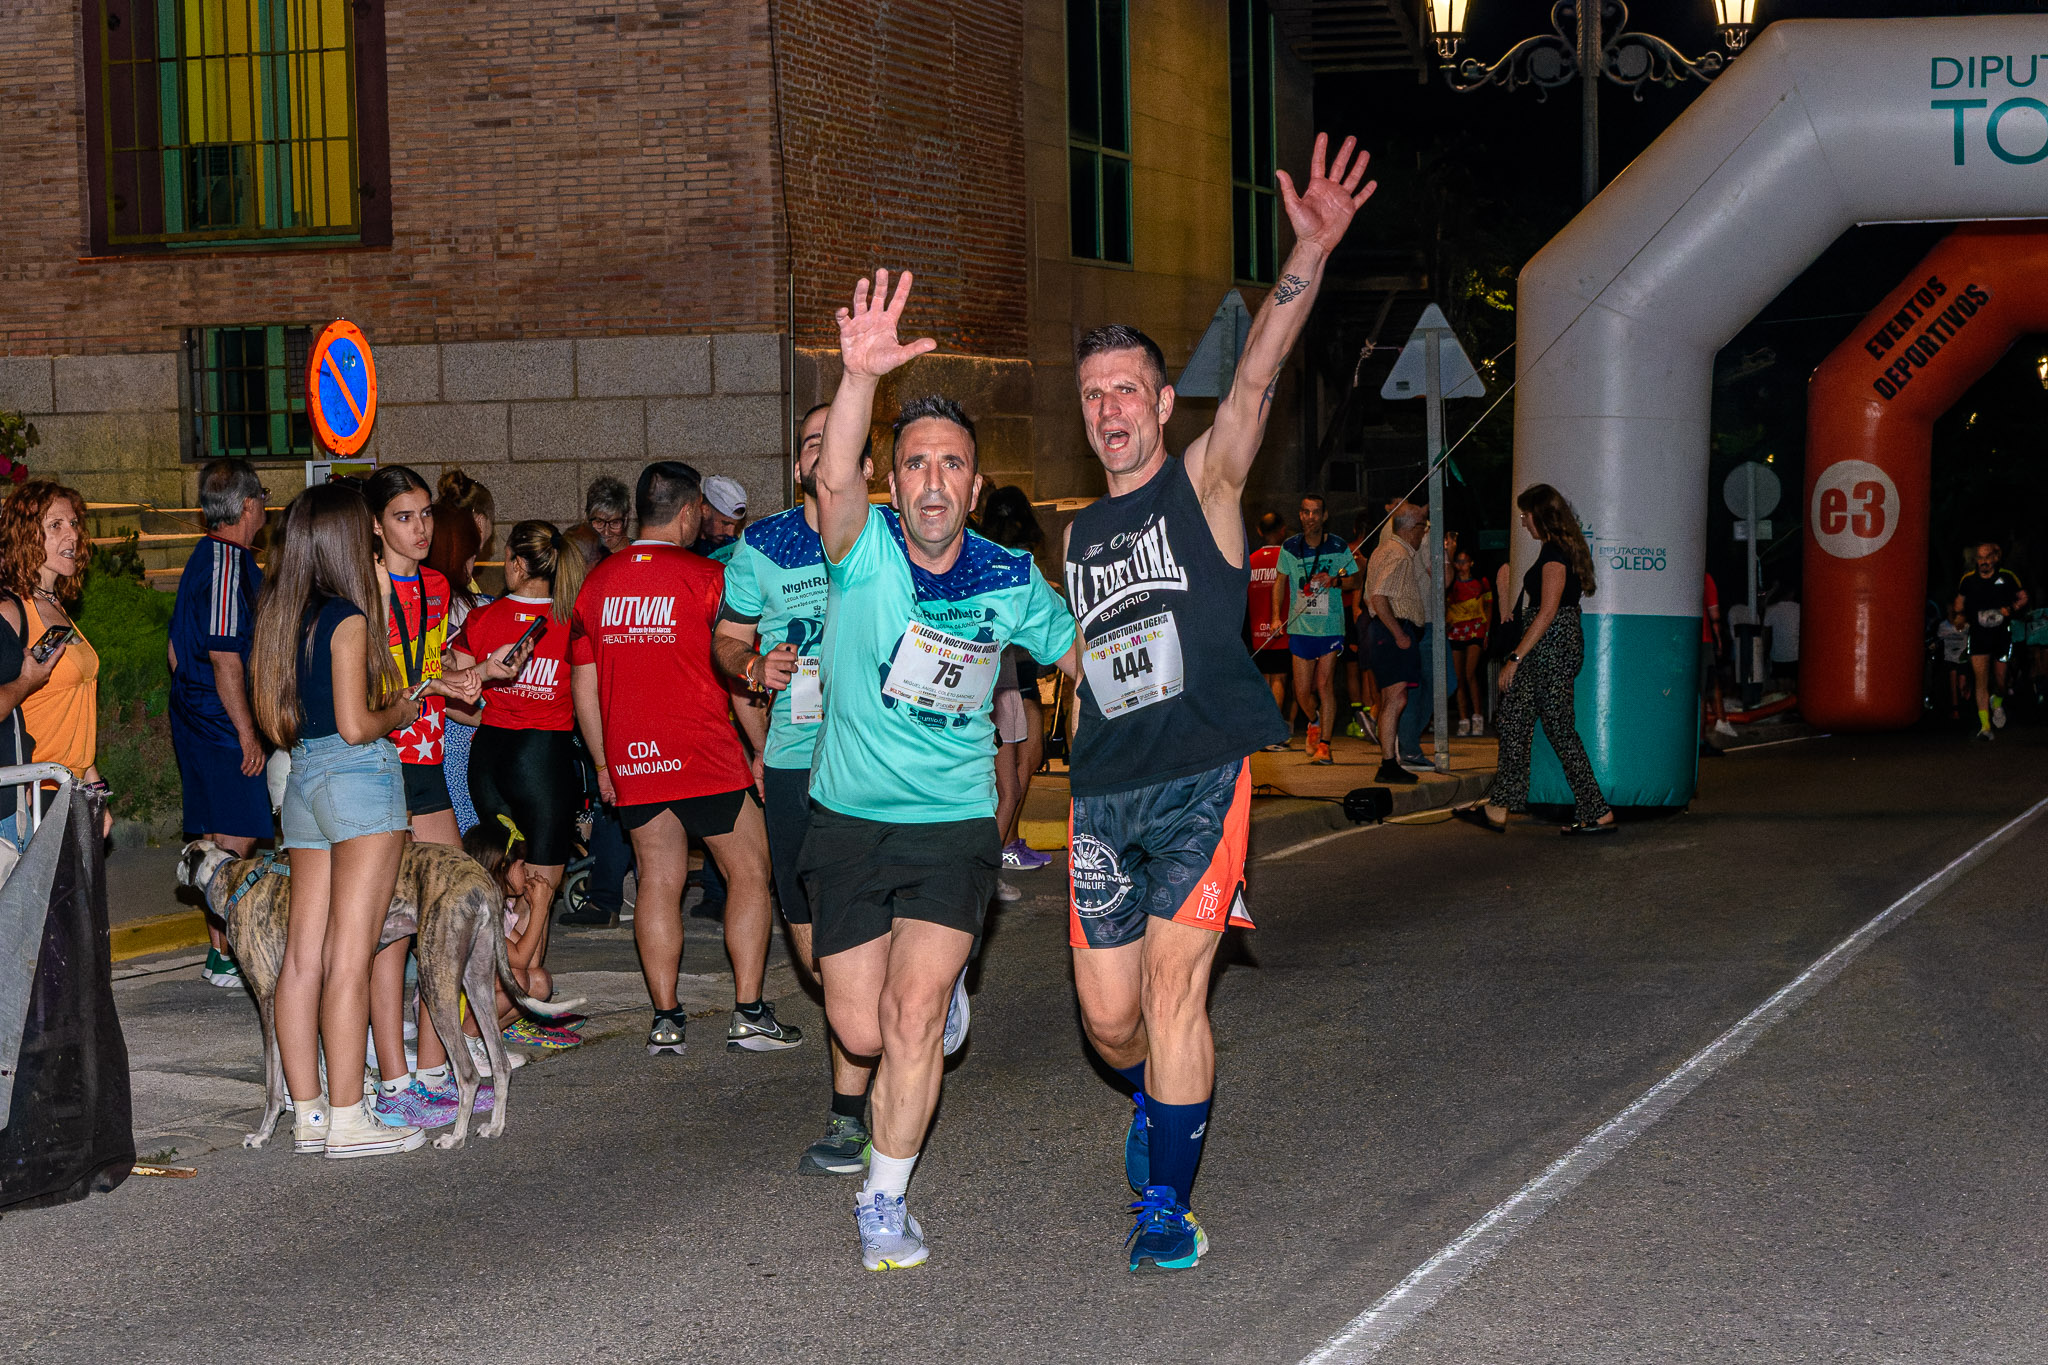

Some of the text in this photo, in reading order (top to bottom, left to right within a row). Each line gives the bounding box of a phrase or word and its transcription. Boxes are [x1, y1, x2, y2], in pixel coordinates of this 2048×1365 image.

[1930, 97, 2048, 166] TO
[1864, 275, 1948, 361] EVENTOS
[1873, 283, 1991, 400] DEPORTIVOS
[1819, 480, 1886, 539] e3
[1082, 542, 1105, 561] The
[1599, 546, 1667, 557] DIPUTACIÓN DE
[1610, 556, 1667, 572] OLEDO
[601, 596, 677, 628] NUTWIN.
[1100, 591, 1151, 622] BARRIO
[602, 635, 676, 644] HEALTH & FOOD
[911, 623, 922, 635] XI
[919, 627, 943, 643] LEGUA
[943, 635, 982, 653] NOCTURNA
[1090, 634, 1108, 650] LEGUA
[1108, 622, 1143, 642] NOCTURNA
[1143, 614, 1169, 629] UGENA
[518, 657, 560, 687] WIN.
[932, 659, 965, 689] 75
[1112, 646, 1154, 683] 444
[493, 686, 519, 696] EALTH
[520, 690, 526, 698] &
[527, 691, 555, 700] FOOD
[627, 740, 660, 759] CDA
[615, 758, 682, 777] VALMOJADO
[1084, 872, 1106, 880] TEAM
[1091, 881, 1106, 890] LIFE
